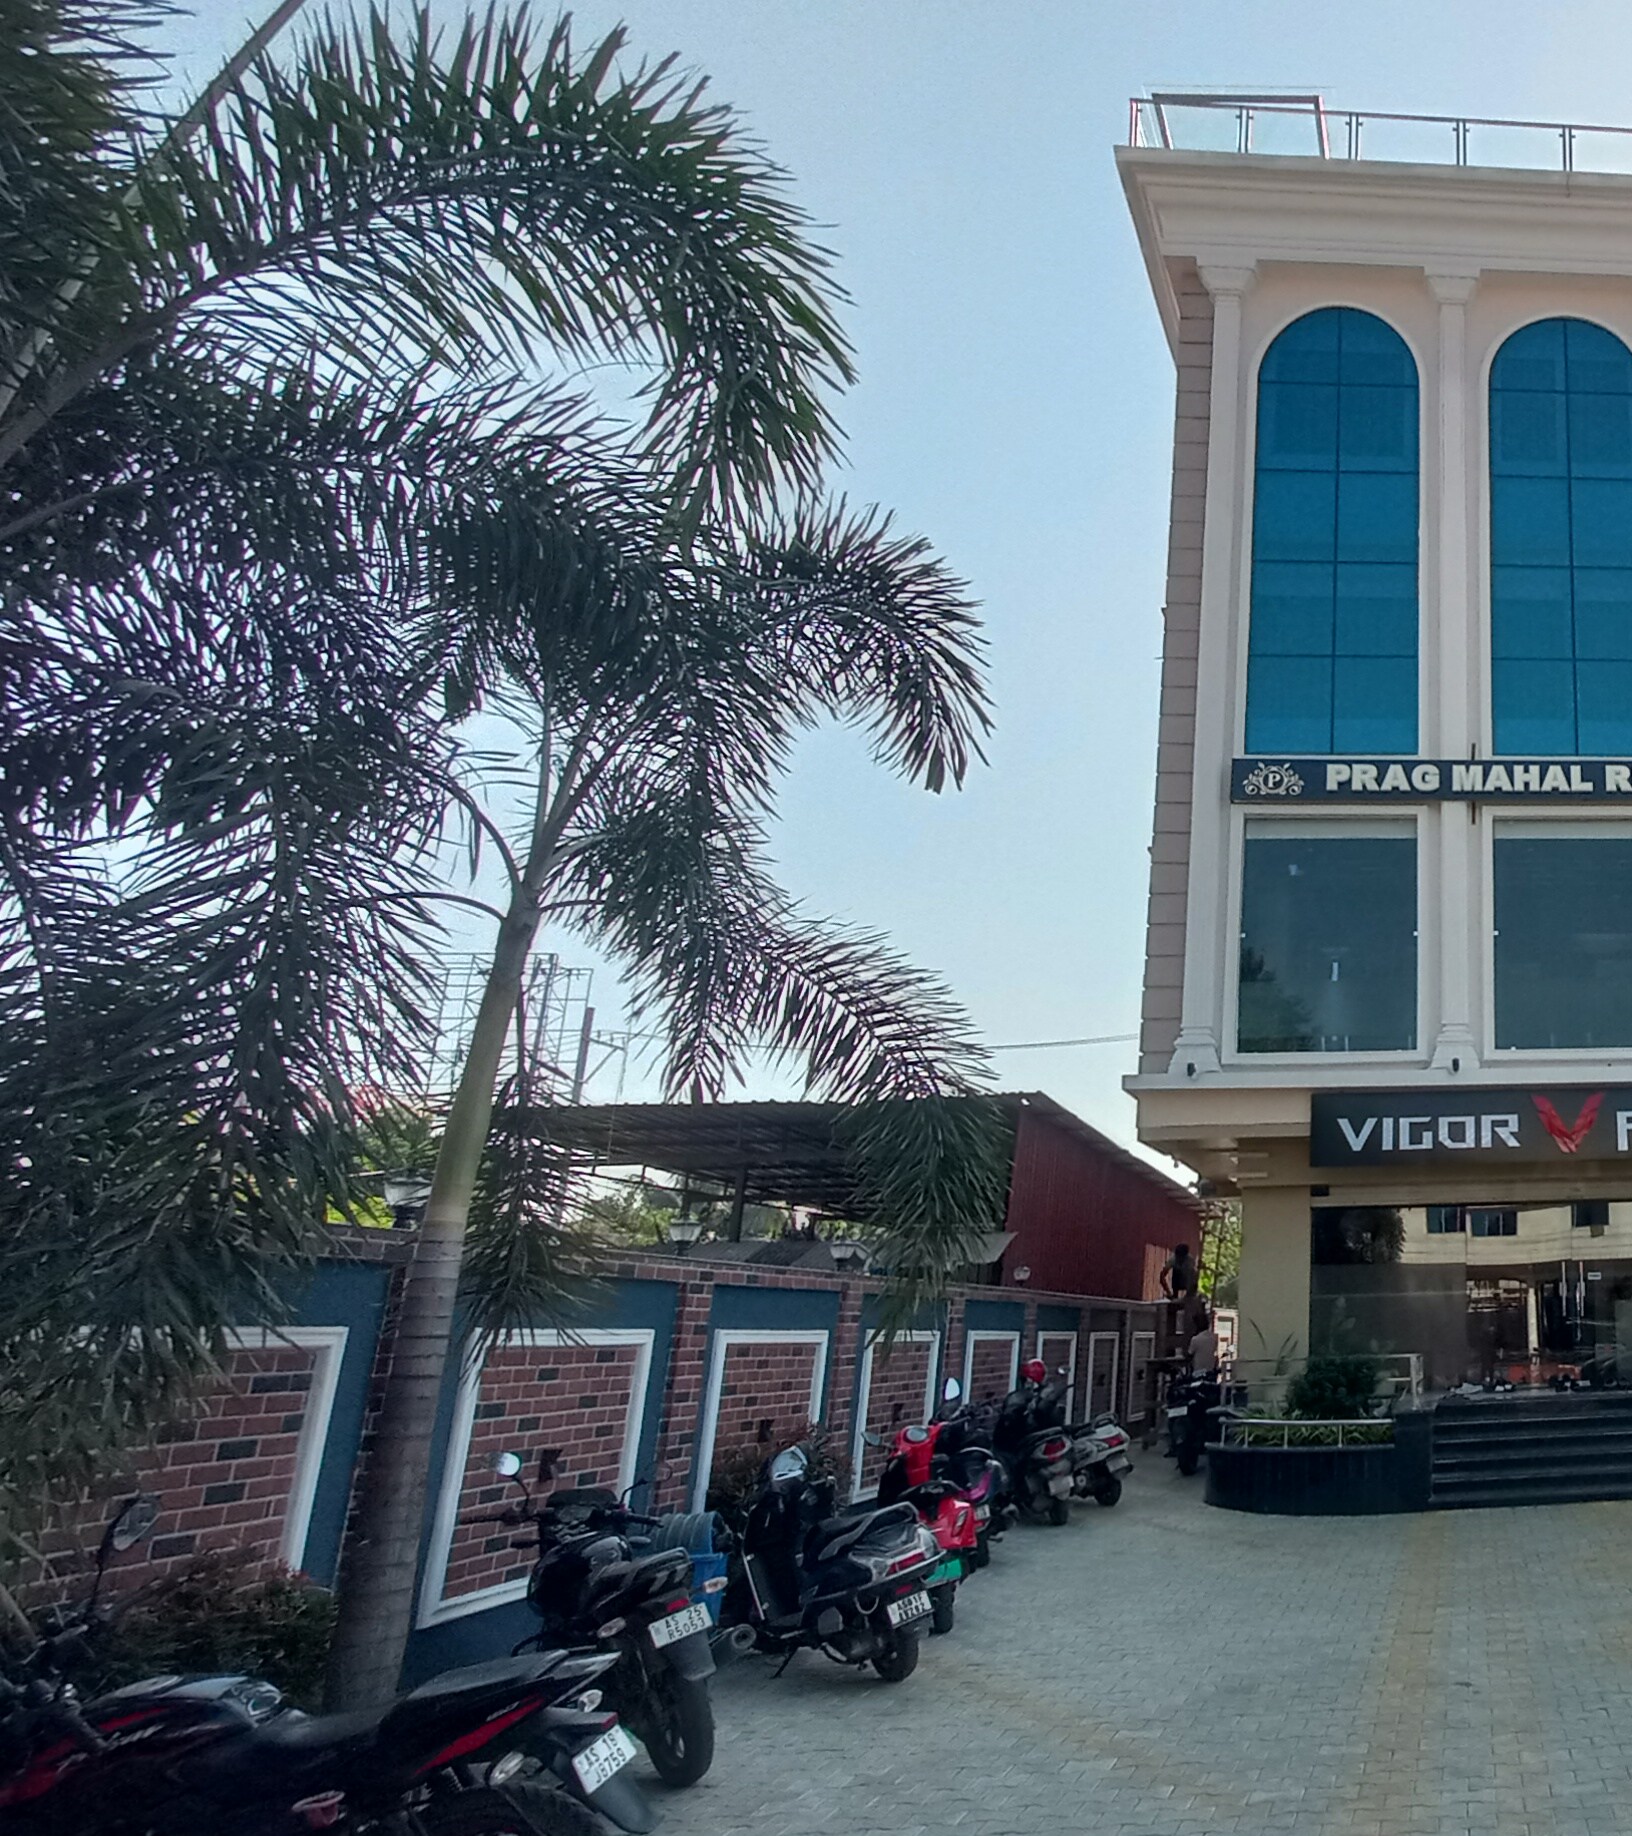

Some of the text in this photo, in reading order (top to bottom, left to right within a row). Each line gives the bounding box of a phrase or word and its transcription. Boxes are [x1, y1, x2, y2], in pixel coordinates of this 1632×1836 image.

[1325, 763, 1441, 792] PRAG
[1452, 764, 1594, 792] MAHAL
[1336, 1113, 1522, 1152] VIGOR
[686, 1606, 702, 1620] 25
[667, 1617, 706, 1640] R5053
